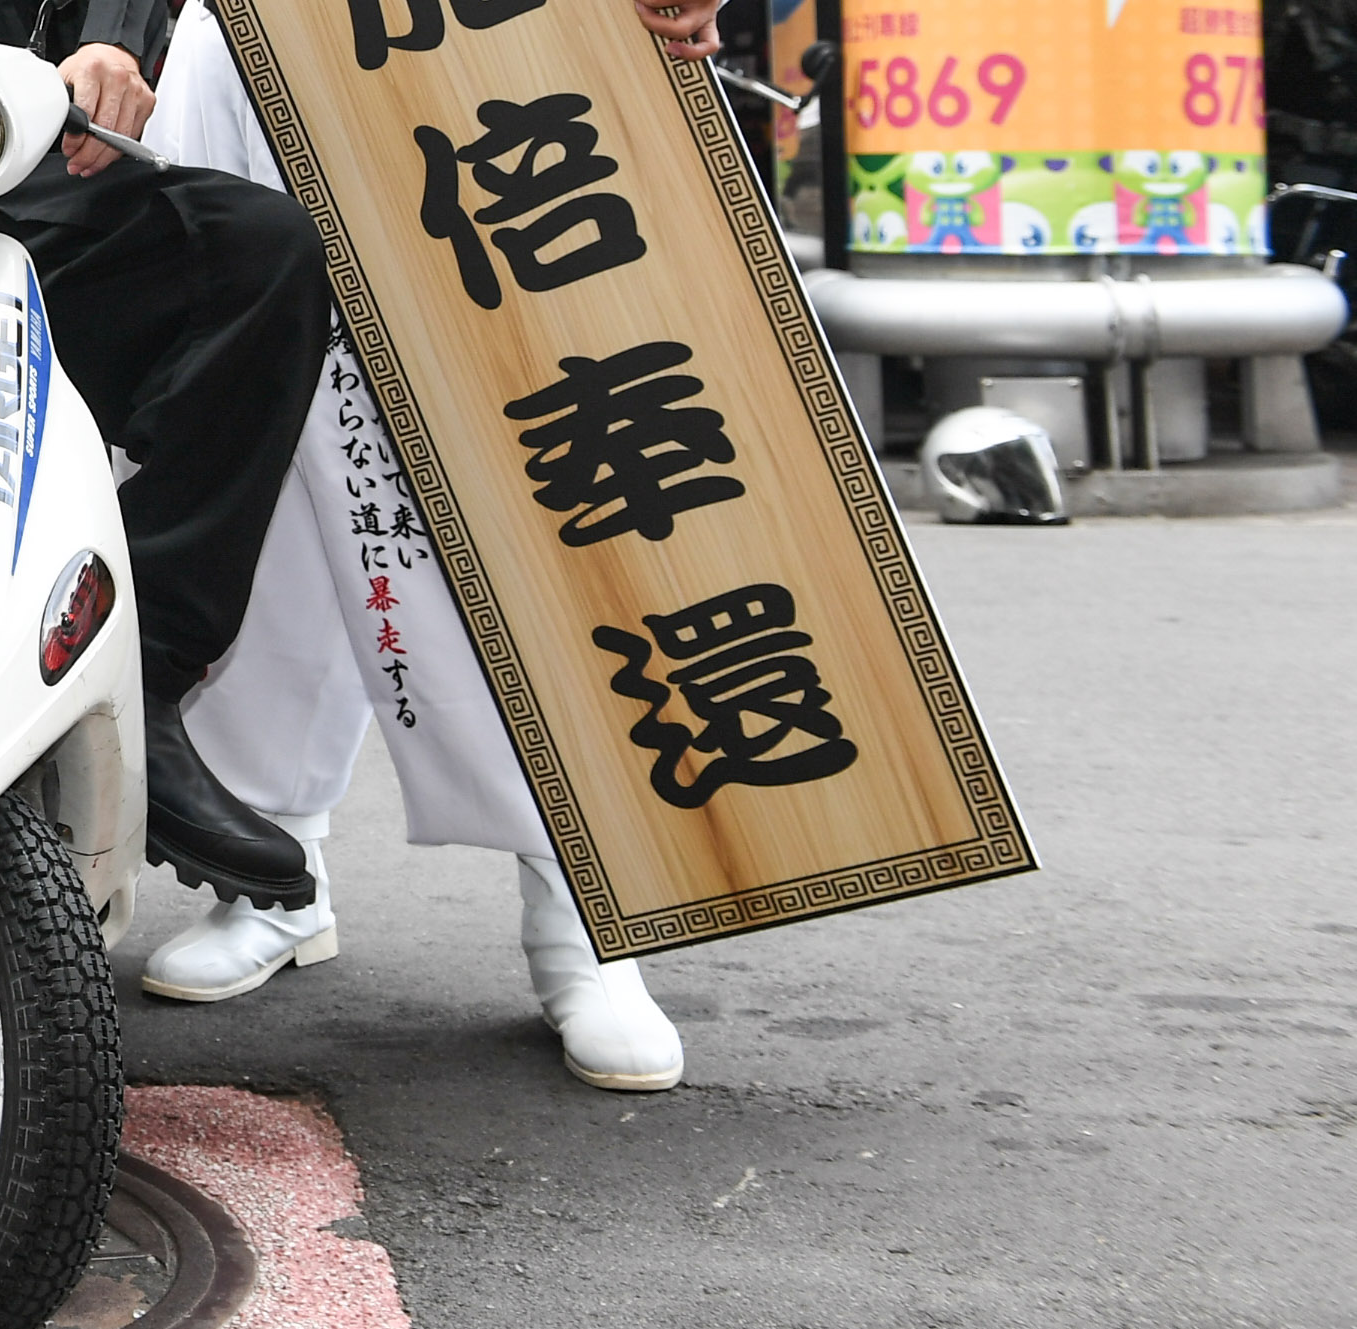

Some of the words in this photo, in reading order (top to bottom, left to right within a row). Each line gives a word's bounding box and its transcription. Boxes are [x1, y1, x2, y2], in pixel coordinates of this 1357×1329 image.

[29, 307, 42, 361] YAMAHA
[27, 364, 38, 414] SPORTS
[24, 414, 36, 458] SUPER
